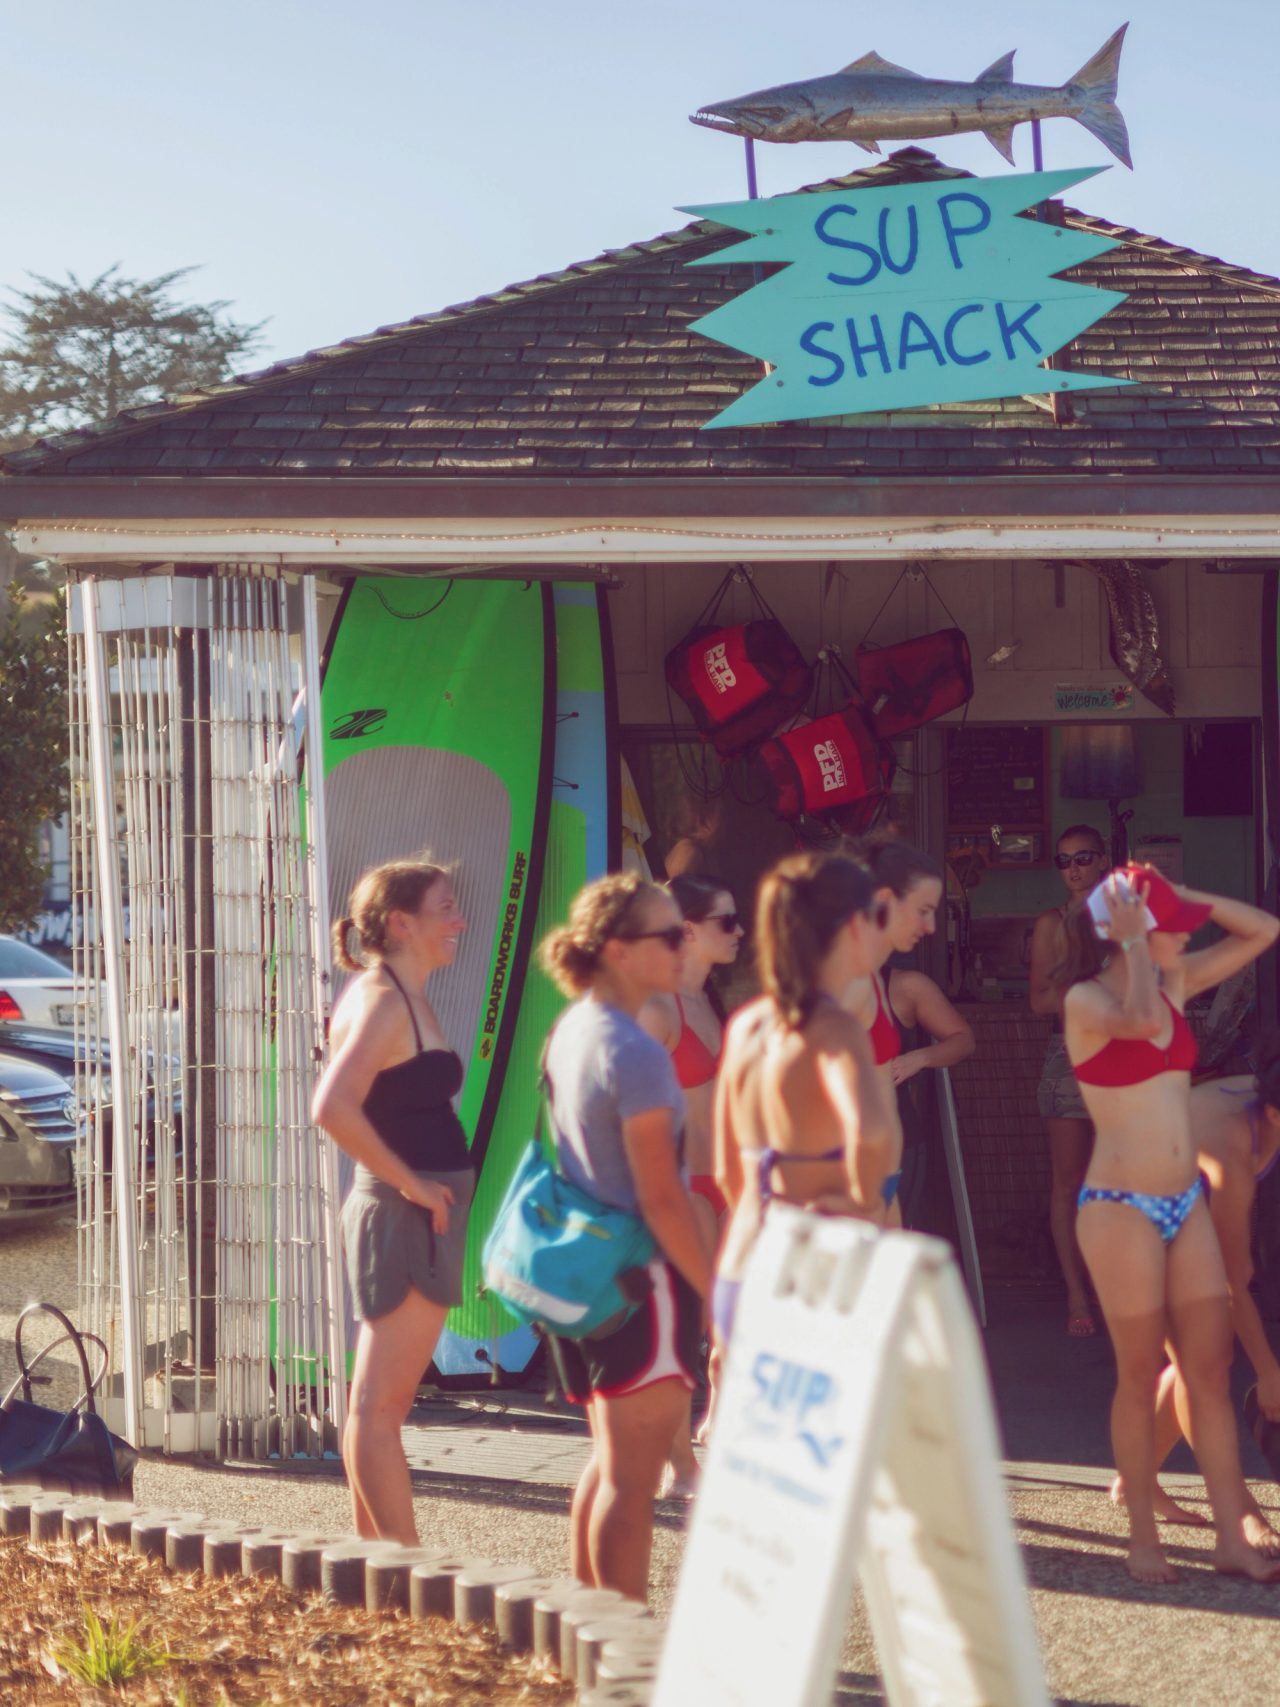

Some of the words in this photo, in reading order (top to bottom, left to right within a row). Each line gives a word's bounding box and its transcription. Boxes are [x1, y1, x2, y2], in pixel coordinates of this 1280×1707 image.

[814, 192, 991, 287] SUP
[800, 302, 1043, 387] SHACK
[710, 642, 737, 688] PFD
[813, 743, 839, 793] PFD
[483, 902, 519, 1034] BOARDWORKS
[509, 851, 527, 900] SURF
